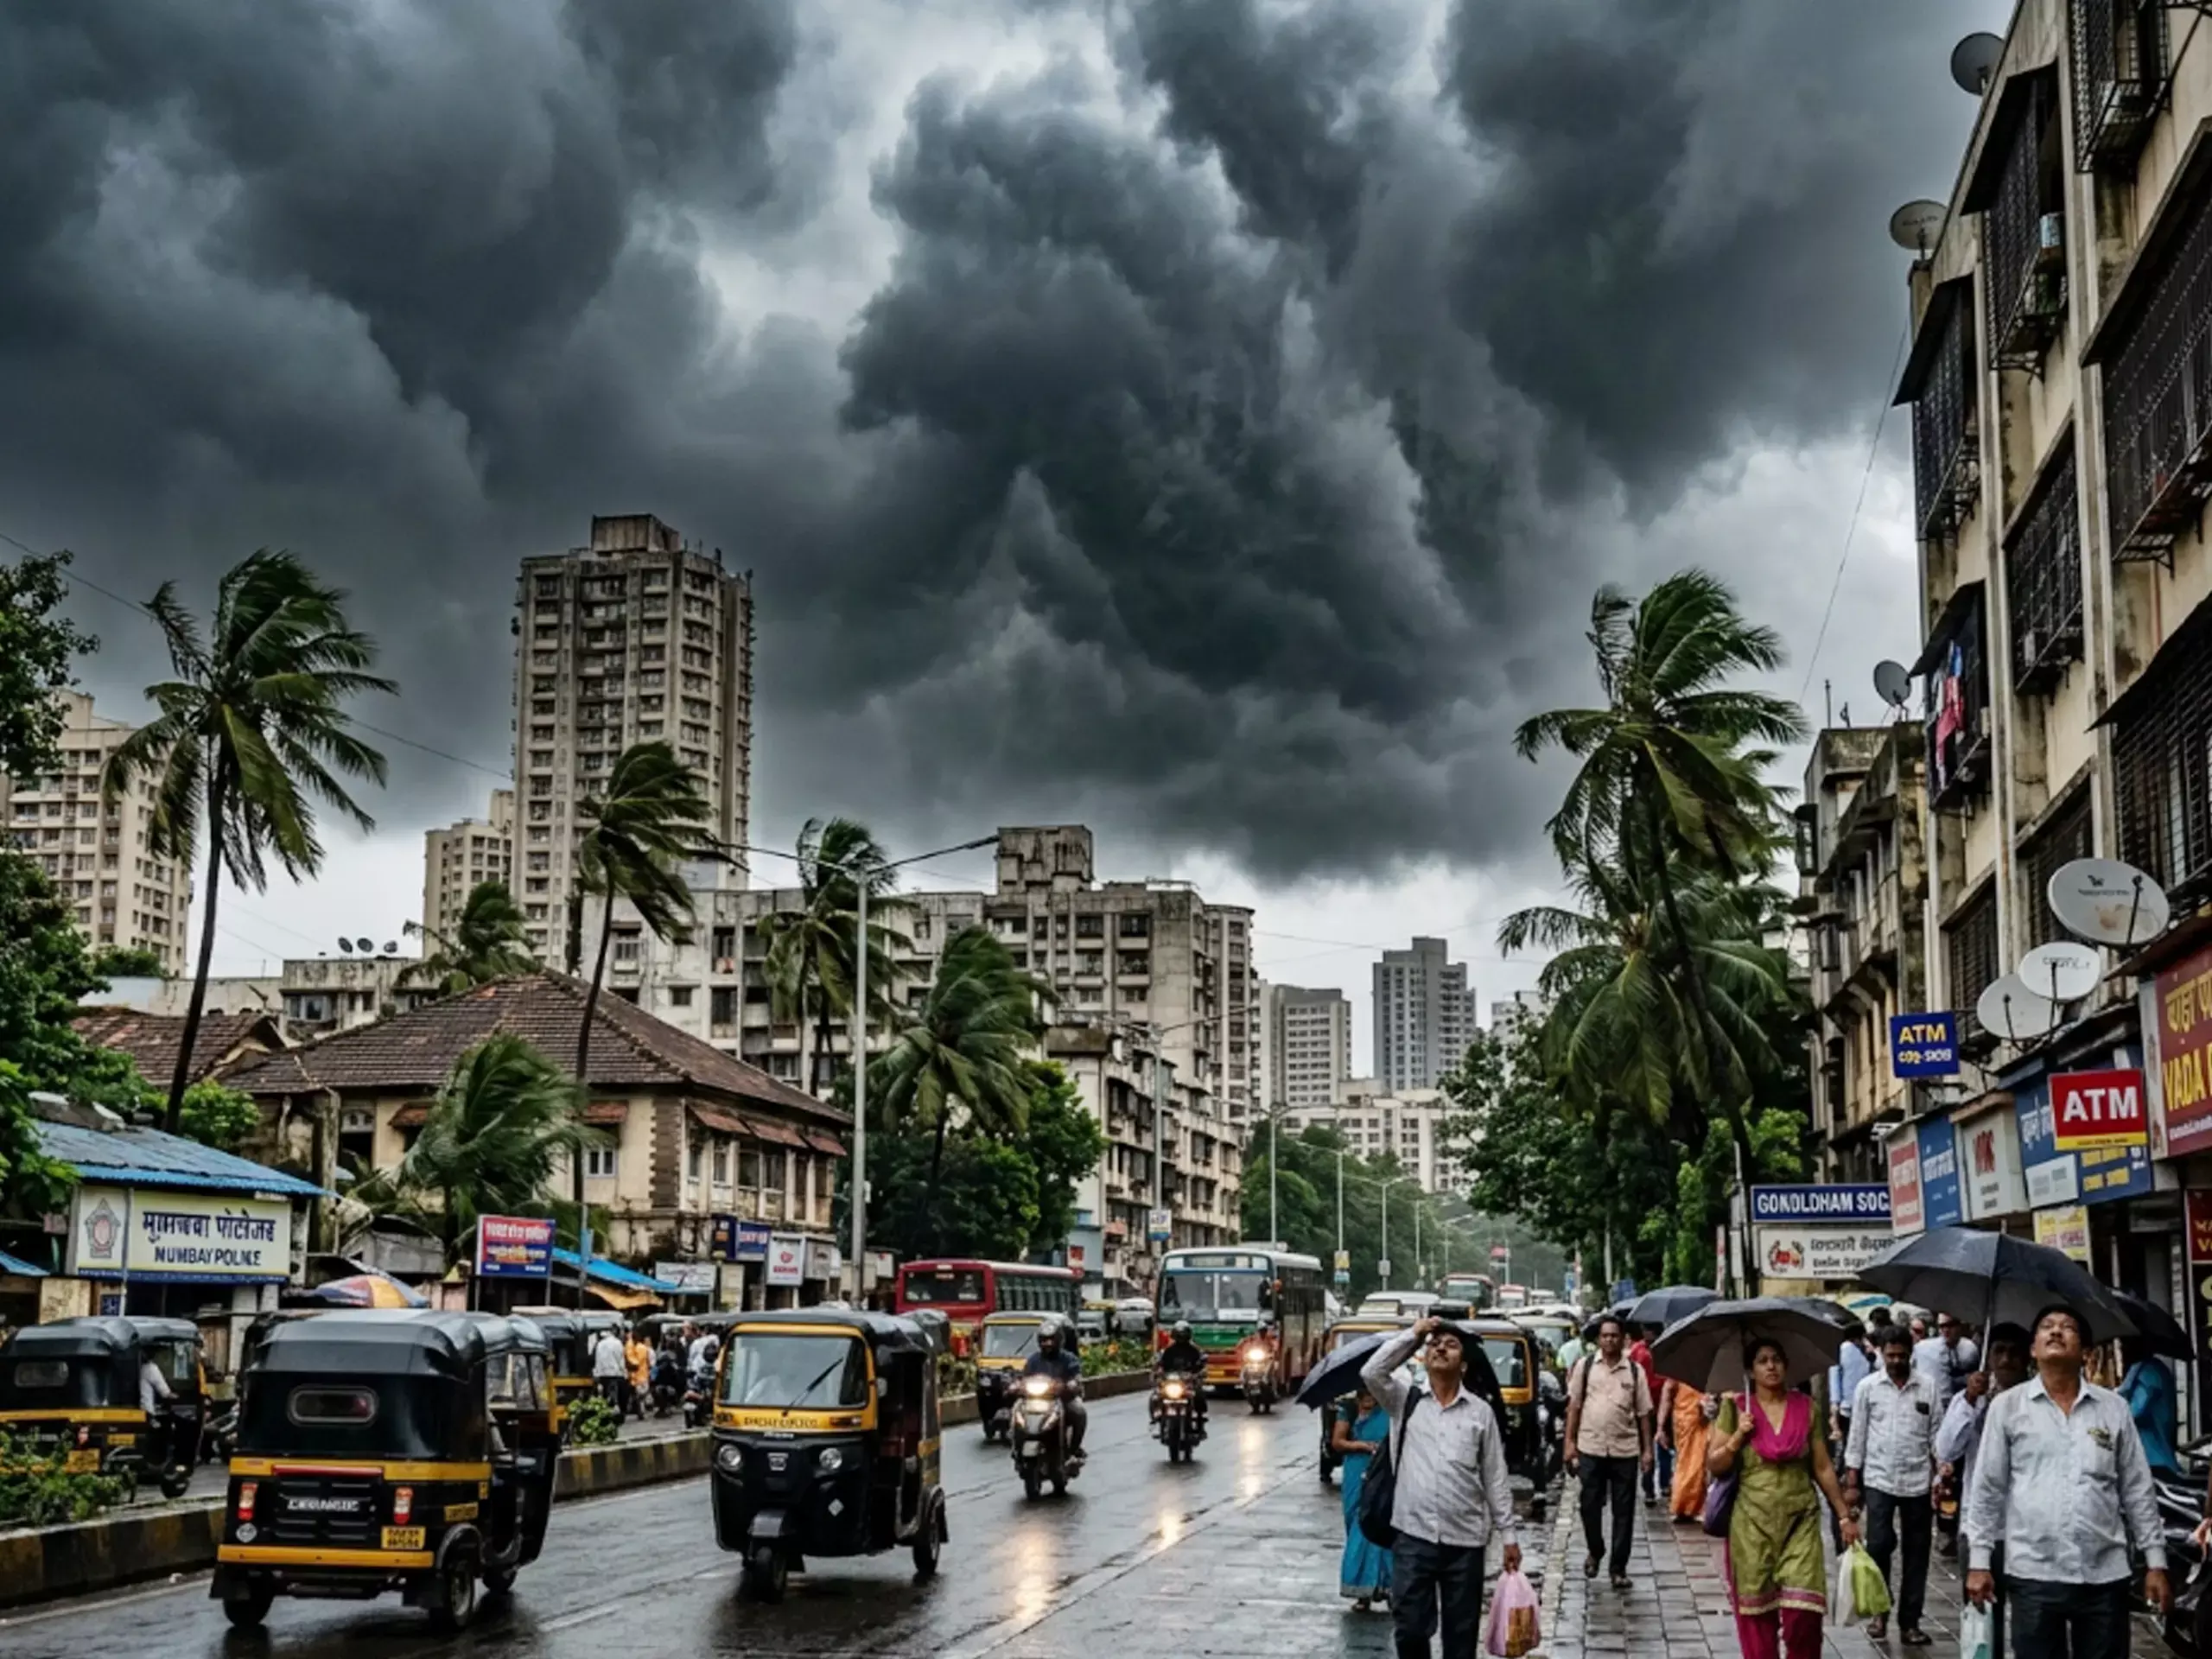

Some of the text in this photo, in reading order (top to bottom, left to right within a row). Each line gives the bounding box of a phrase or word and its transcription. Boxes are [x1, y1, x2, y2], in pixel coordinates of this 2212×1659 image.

[1898, 1023, 1947, 1045] ATM
[2163, 1046, 2206, 1112] VADA
[2063, 1085, 2139, 1122] ATM
